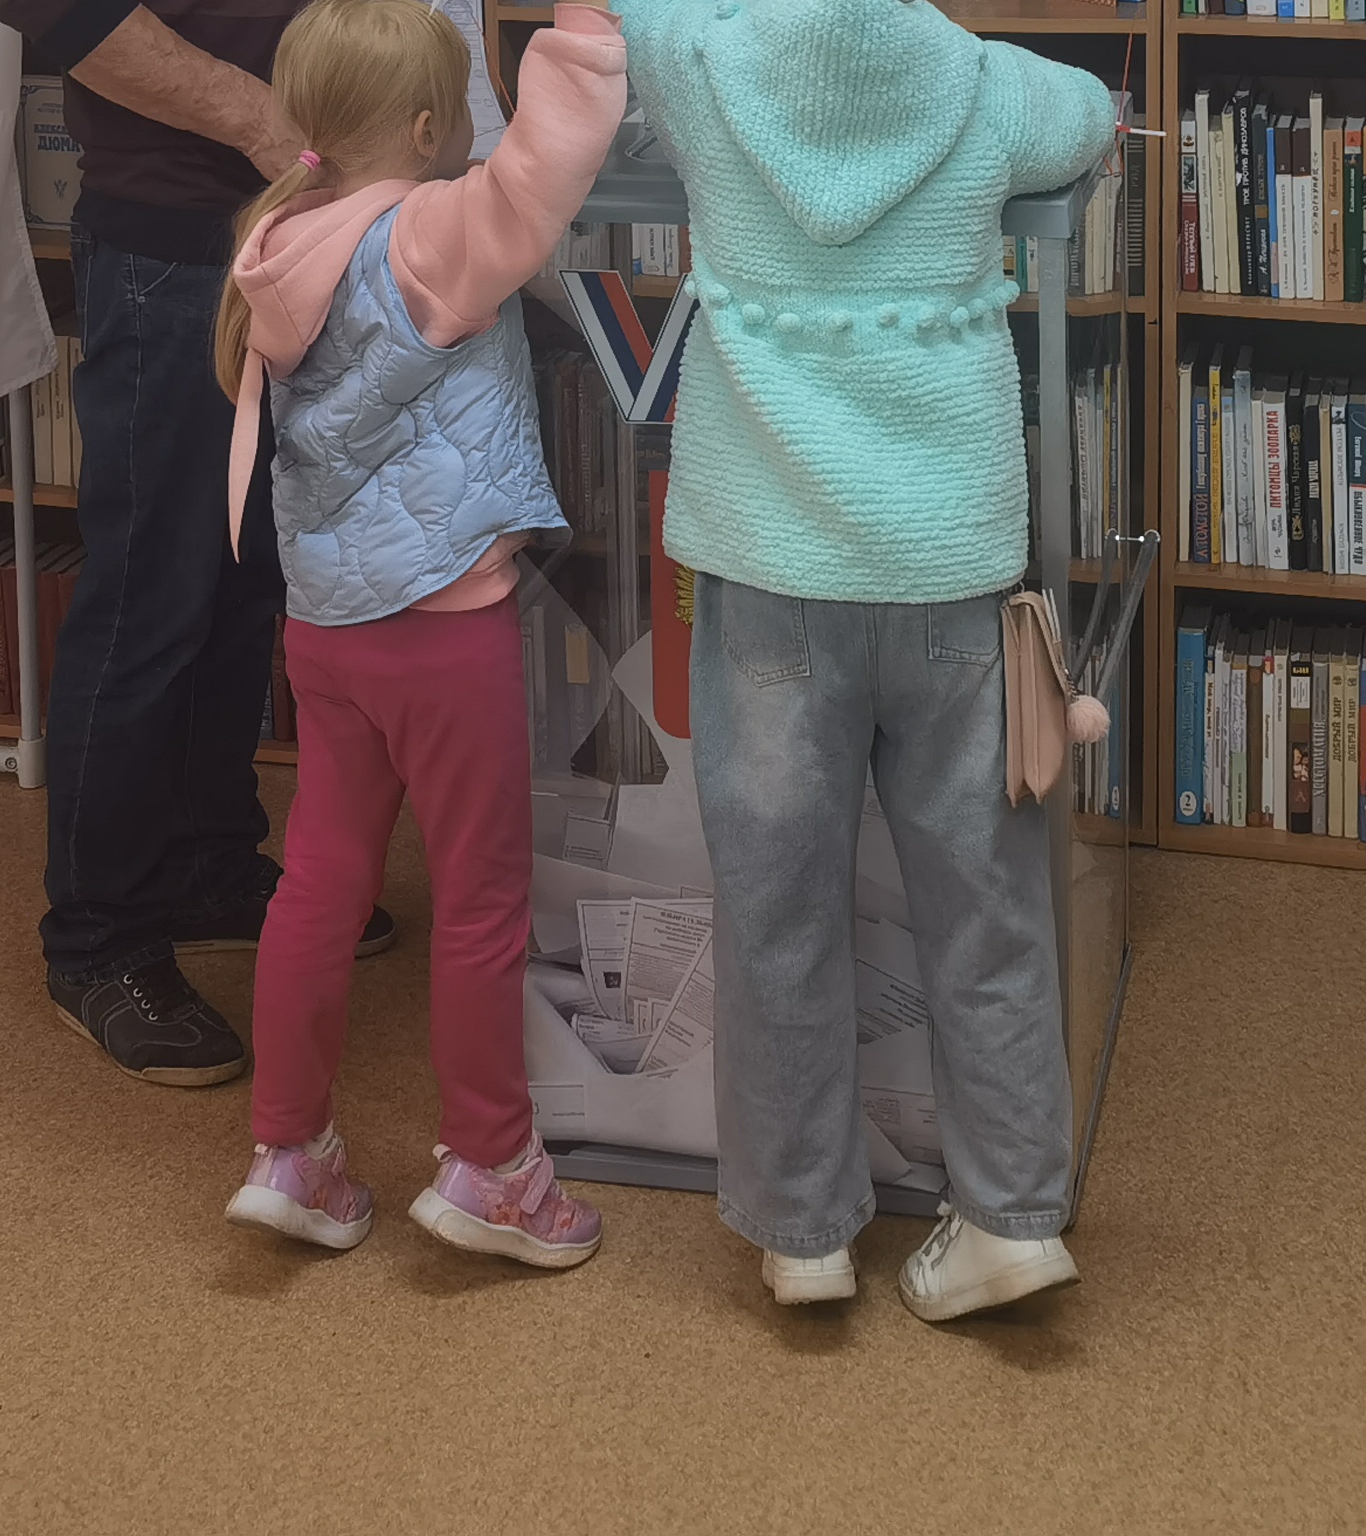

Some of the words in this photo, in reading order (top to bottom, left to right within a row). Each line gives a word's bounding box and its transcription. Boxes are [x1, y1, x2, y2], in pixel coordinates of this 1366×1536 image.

[1240, 107, 1249, 155] ДИНОЗАВРОВ
[1241, 158, 1249, 186] ПРОТИВ
[1266, 410, 1280, 459] ЗООПАРКА
[1268, 462, 1281, 509] ПИТОМЦЫ
[1195, 494, 1208, 544] ТОЛСТОЙ
[1353, 491, 1363, 544] ОБЫКНОВЕННОЕ
[1334, 697, 1342, 717] МИР
[1332, 722, 1342, 762] ДОБРЫЙ
[1348, 723, 1356, 762] ДОБРЫЙ
